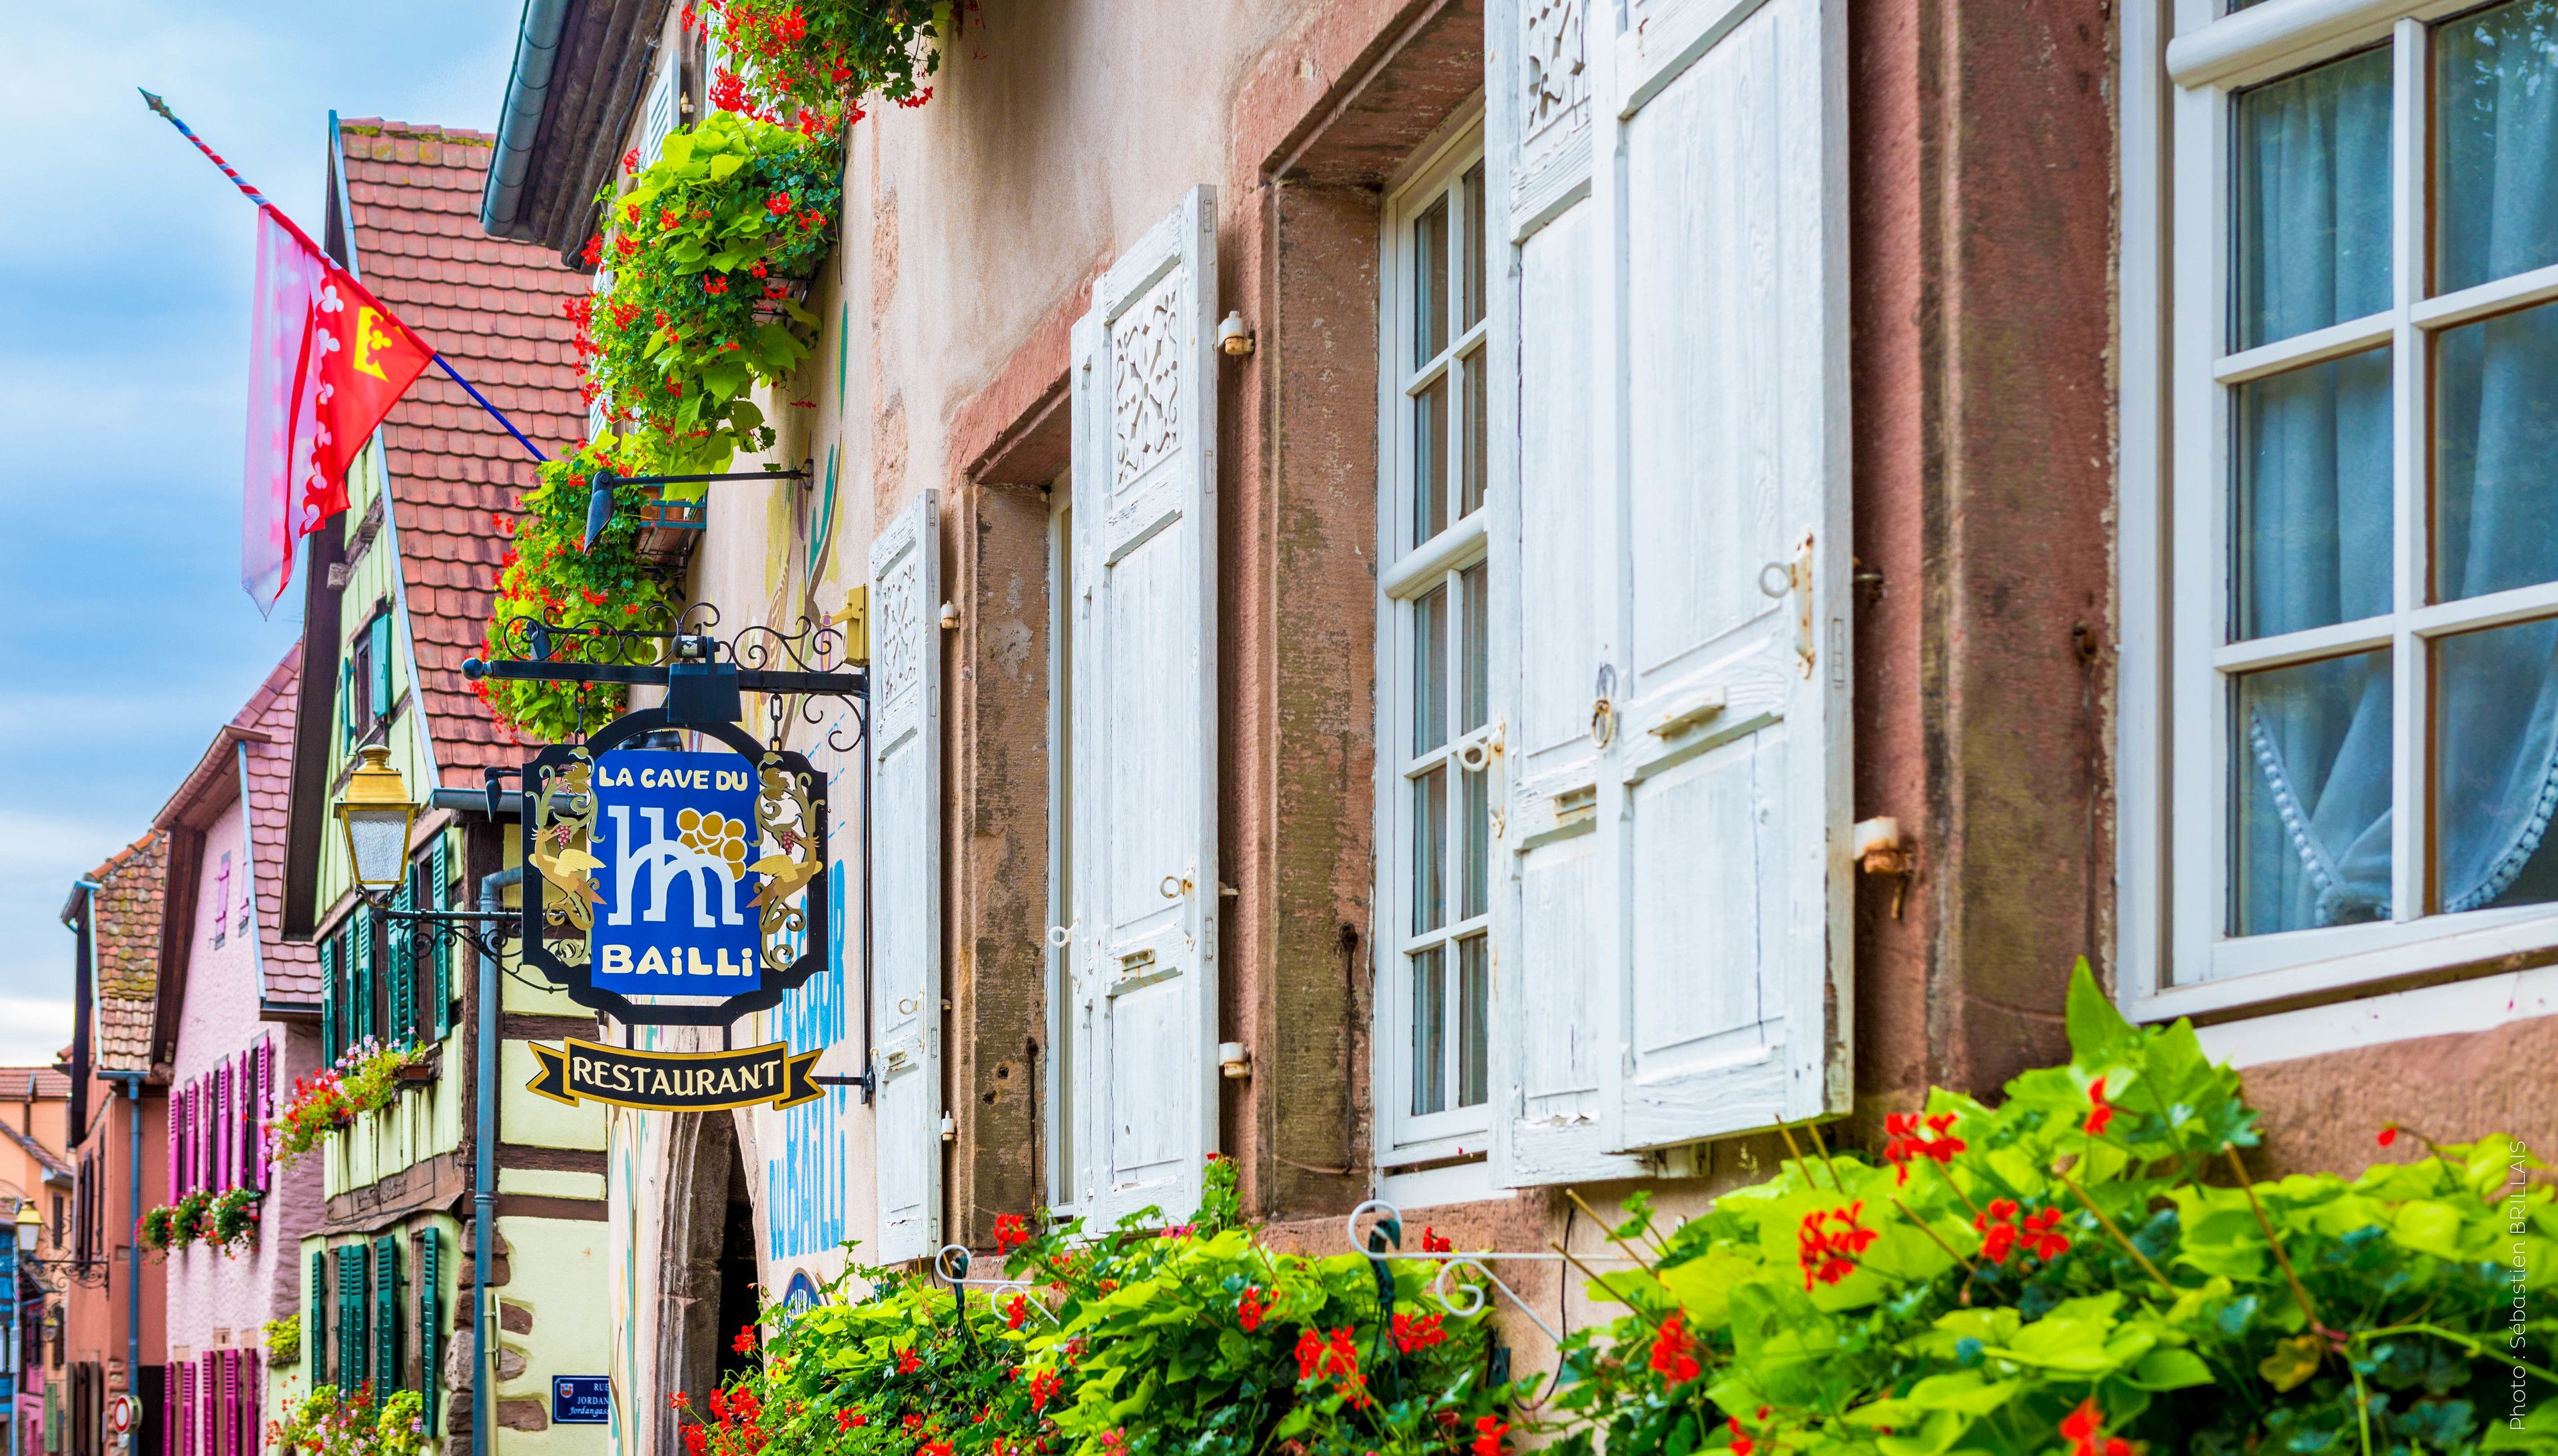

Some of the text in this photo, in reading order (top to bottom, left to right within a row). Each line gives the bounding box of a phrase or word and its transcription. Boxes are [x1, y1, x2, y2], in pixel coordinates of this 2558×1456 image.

[599, 766, 748, 791] LA CAVE DU
[572, 1056, 781, 1096] RESTAURANT
[769, 1156, 785, 1262] DU
[594, 1383, 610, 1391] RUE
[577, 1396, 609, 1405] JORDAN
[568, 1405, 609, 1417] Jordangas
